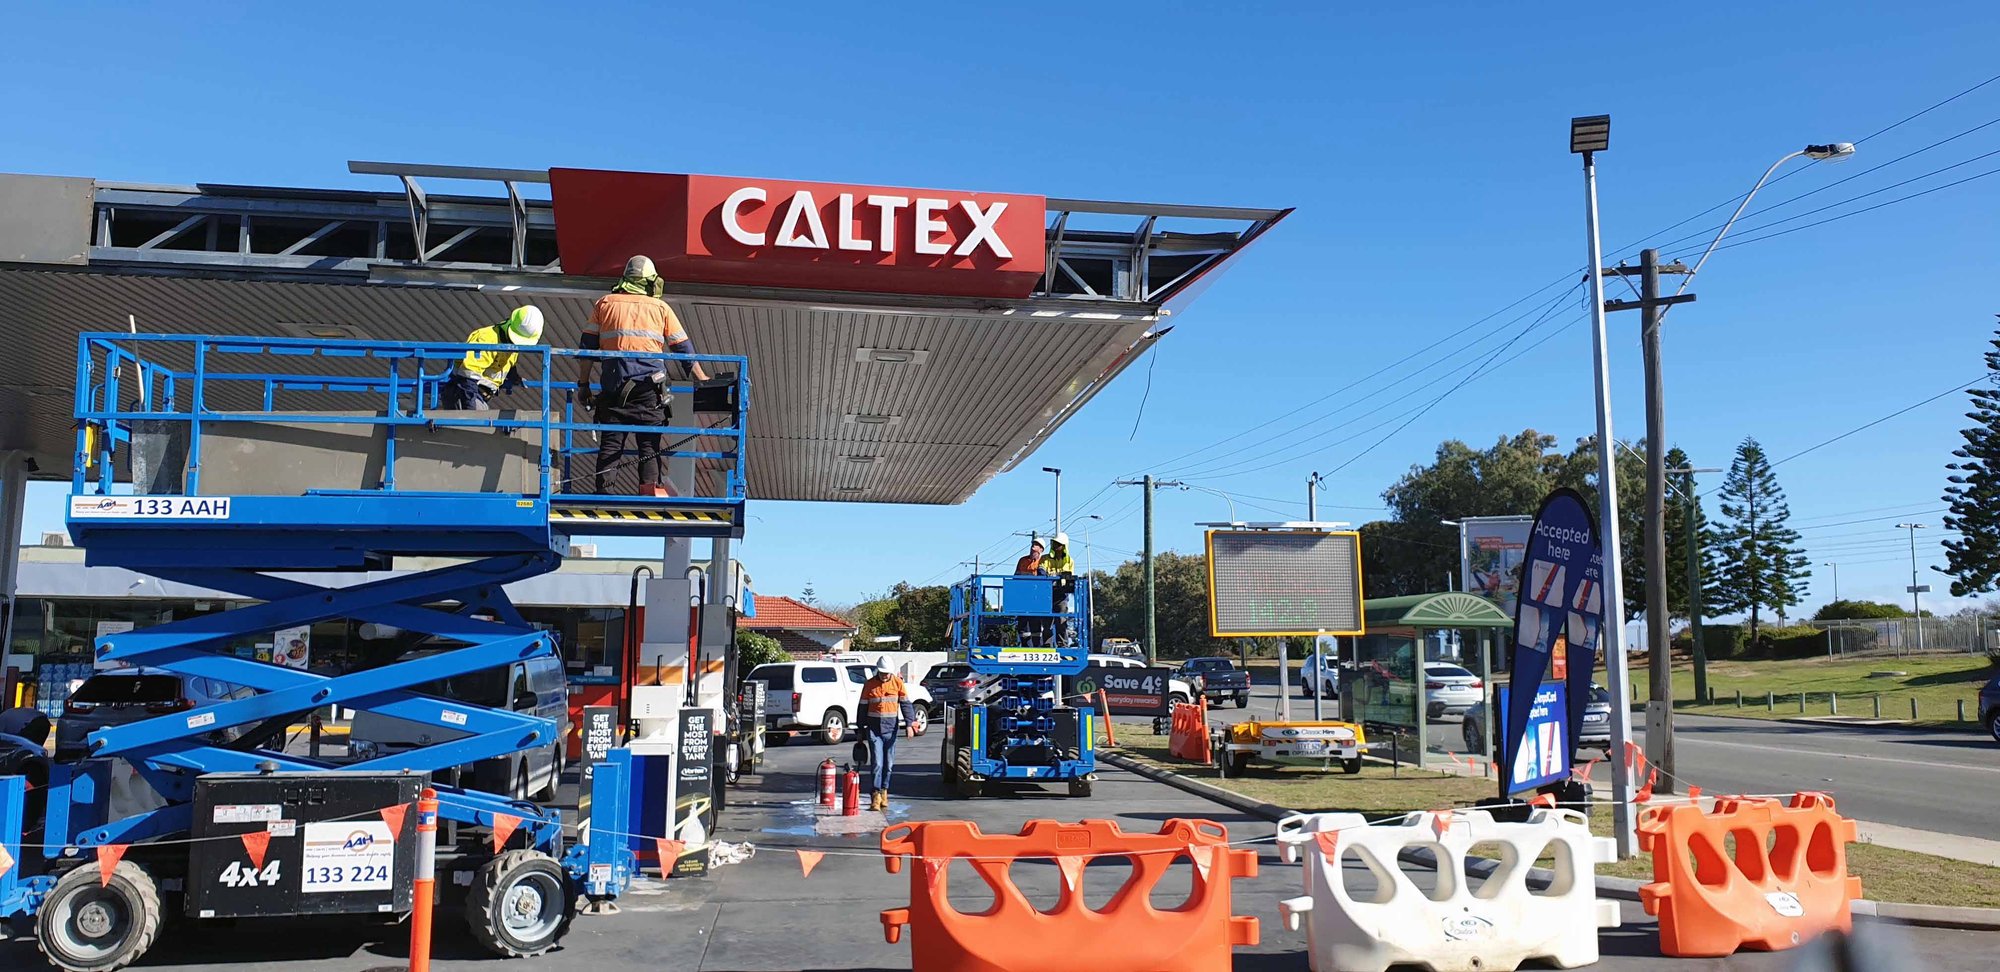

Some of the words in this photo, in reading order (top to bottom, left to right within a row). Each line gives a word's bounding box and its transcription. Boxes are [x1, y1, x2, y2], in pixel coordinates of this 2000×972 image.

[721, 187, 1013, 258] CALTEX
[134, 500, 173, 515] 133
[180, 500, 227, 515] AAH
[1535, 520, 1590, 545] Accepted
[1548, 540, 1571, 560] here
[1023, 653, 1040, 661] 133
[1042, 653, 1059, 662] 224
[1104, 674, 1139, 690] Save
[592, 714, 609, 722] GET
[688, 716, 705, 724] GET
[592, 722, 609, 730] THE
[588, 729, 612, 737] MOST
[684, 731, 708, 739] MOST
[588, 736, 612, 744] FROM
[684, 738, 708, 746] FROM
[682, 745, 709, 753] EVERY
[685, 752, 706, 761] TANK
[343, 834, 374, 850] AAH
[219, 860, 280, 887] 4x4
[306, 866, 343, 884] 133
[351, 865, 388, 882] 224
